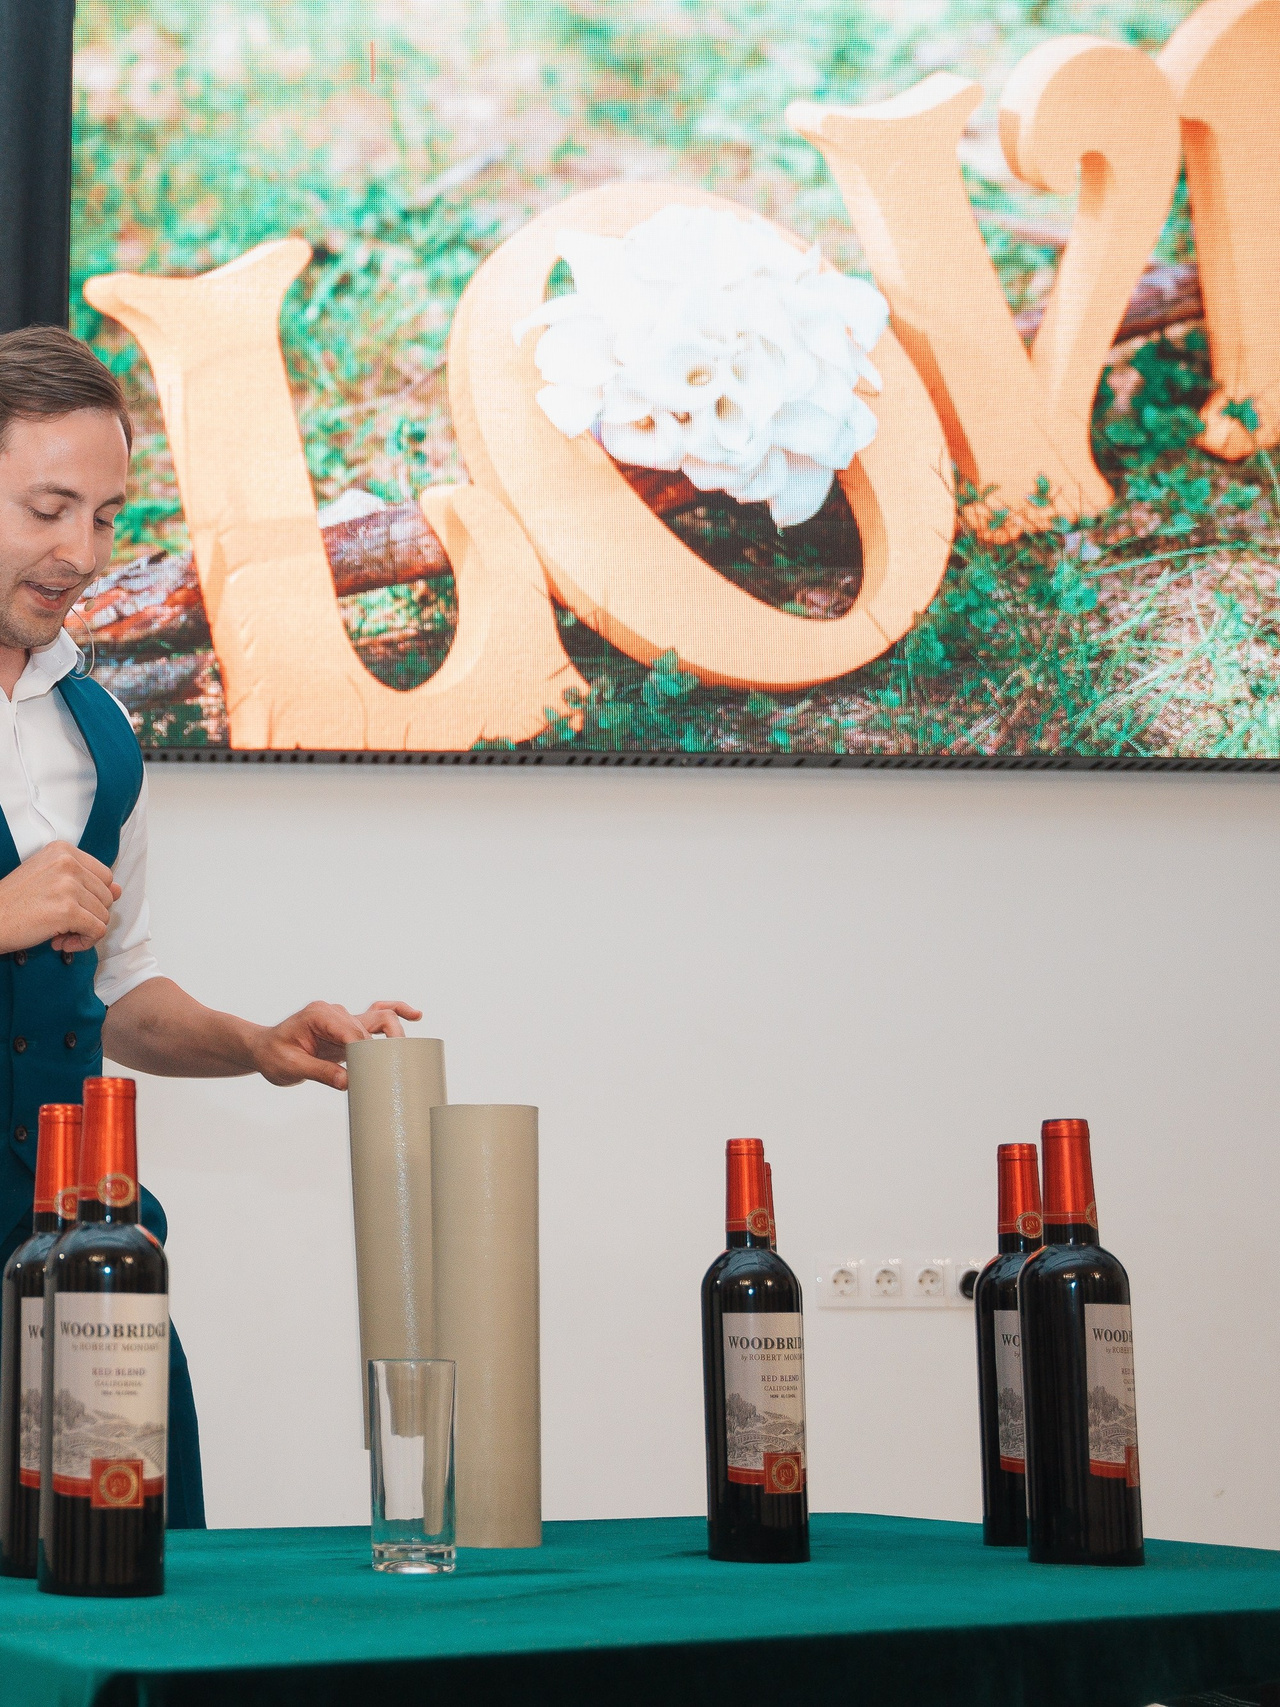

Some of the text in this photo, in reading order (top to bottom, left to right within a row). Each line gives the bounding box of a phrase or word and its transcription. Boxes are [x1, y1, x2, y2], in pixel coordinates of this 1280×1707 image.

[749, 1353, 781, 1361] ROBERT
[92, 1367, 146, 1377] RED BLEND
[761, 1374, 800, 1382] RED BLEND
